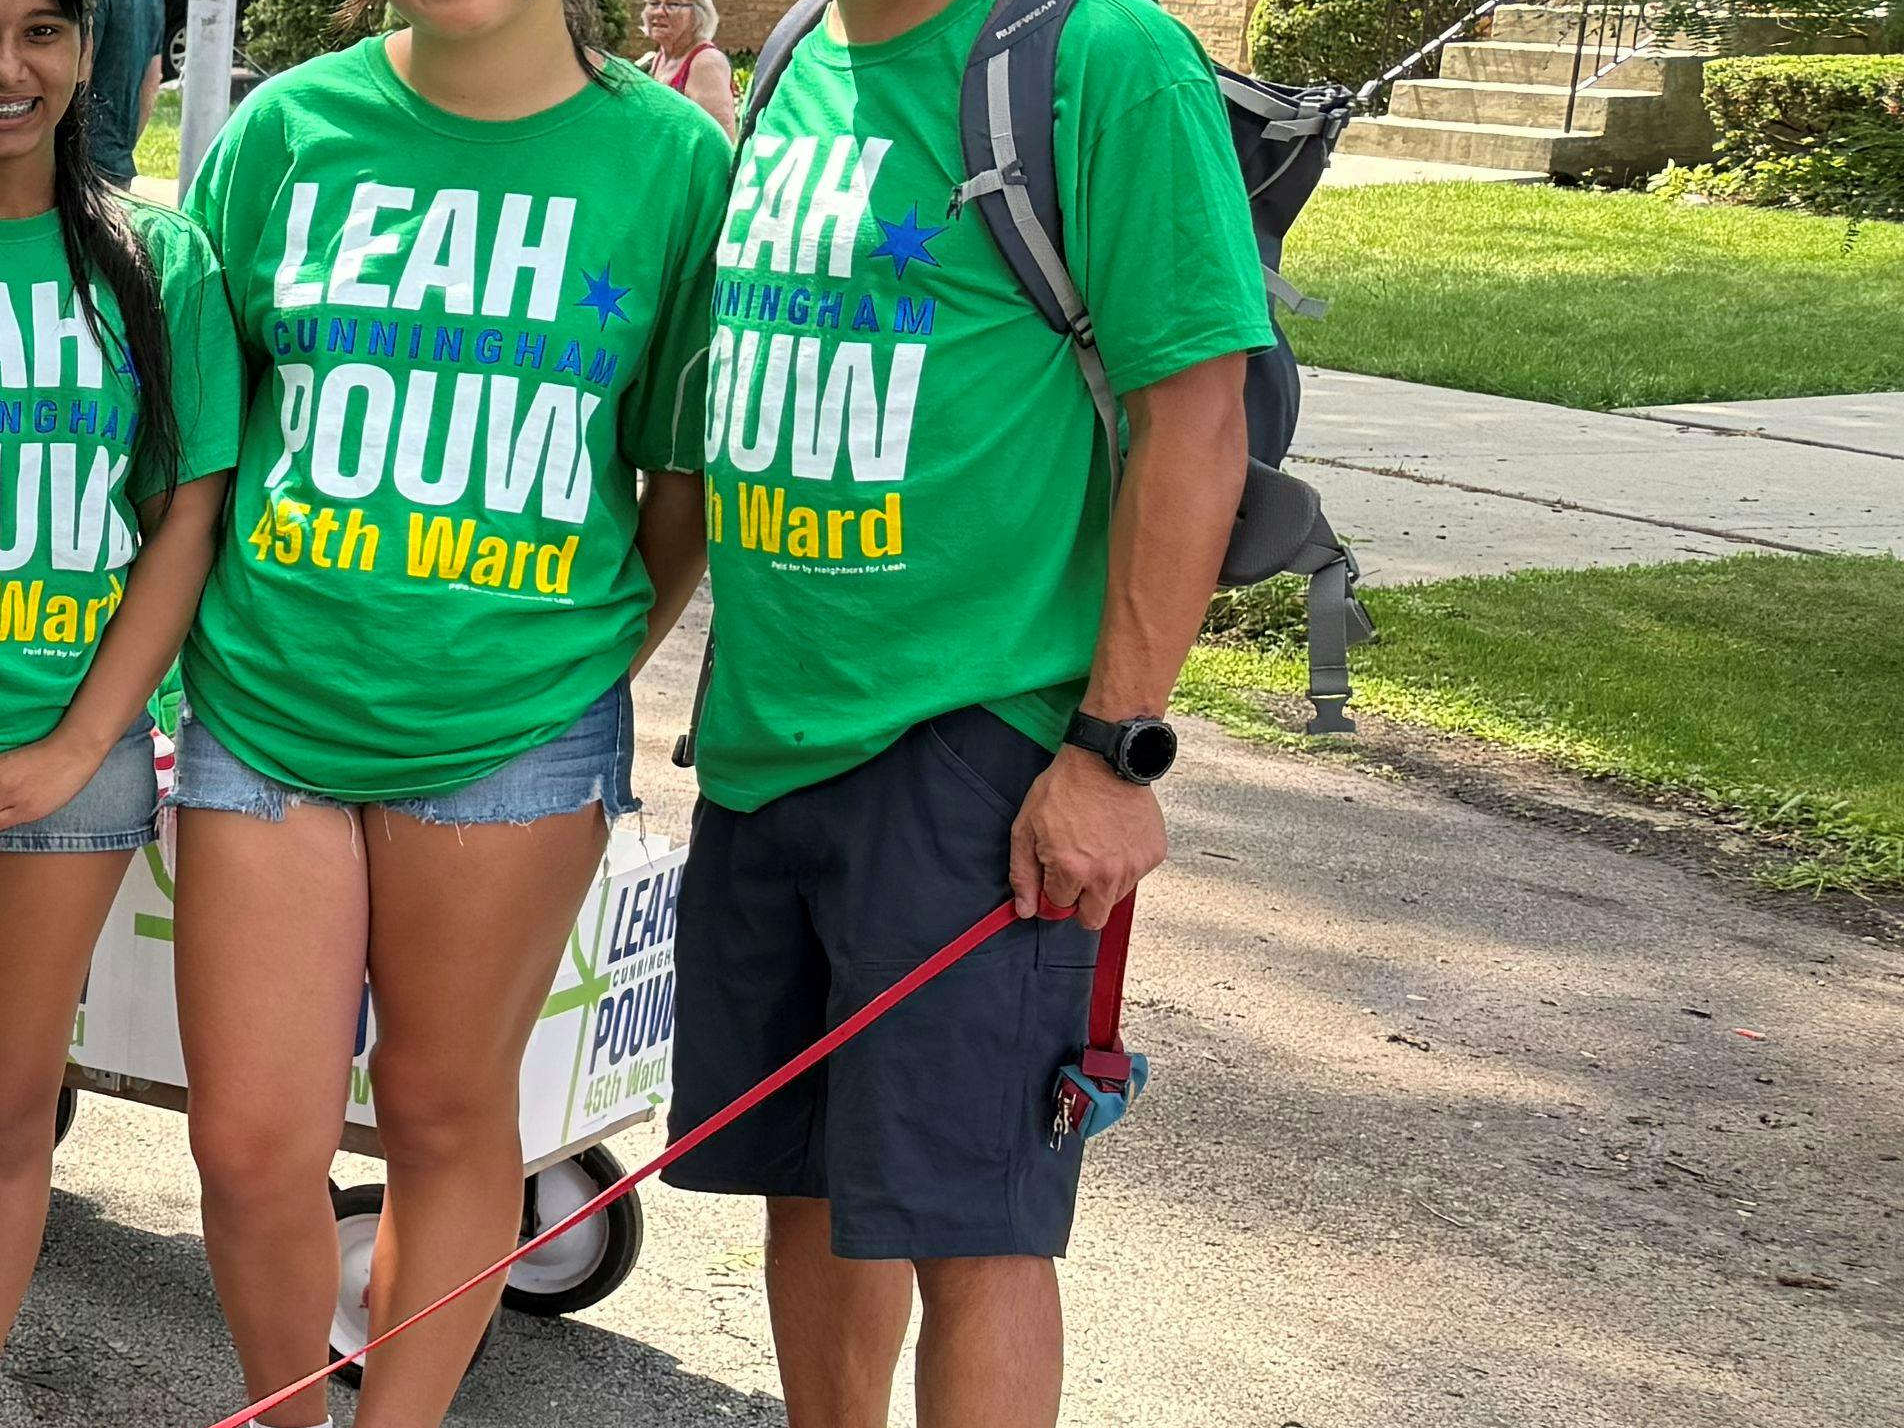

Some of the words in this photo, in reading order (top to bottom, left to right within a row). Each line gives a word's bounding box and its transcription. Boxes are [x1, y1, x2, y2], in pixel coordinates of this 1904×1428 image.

[274, 182, 578, 322] LEAH
[717, 135, 894, 278] EAH
[274, 316, 619, 389] CUNNINGHAM
[715, 279, 936, 336] NINGHAM
[264, 363, 602, 525] POUW
[704, 324, 927, 482] OUW
[248, 498, 380, 572] 45th
[407, 512, 580, 594] Ward
[738, 482, 903, 559] Ward
[607, 863, 684, 966] LEAH
[612, 948, 673, 987] CUNNINGH
[583, 1069, 622, 1119] 45th
[625, 1046, 667, 1100] Ward
